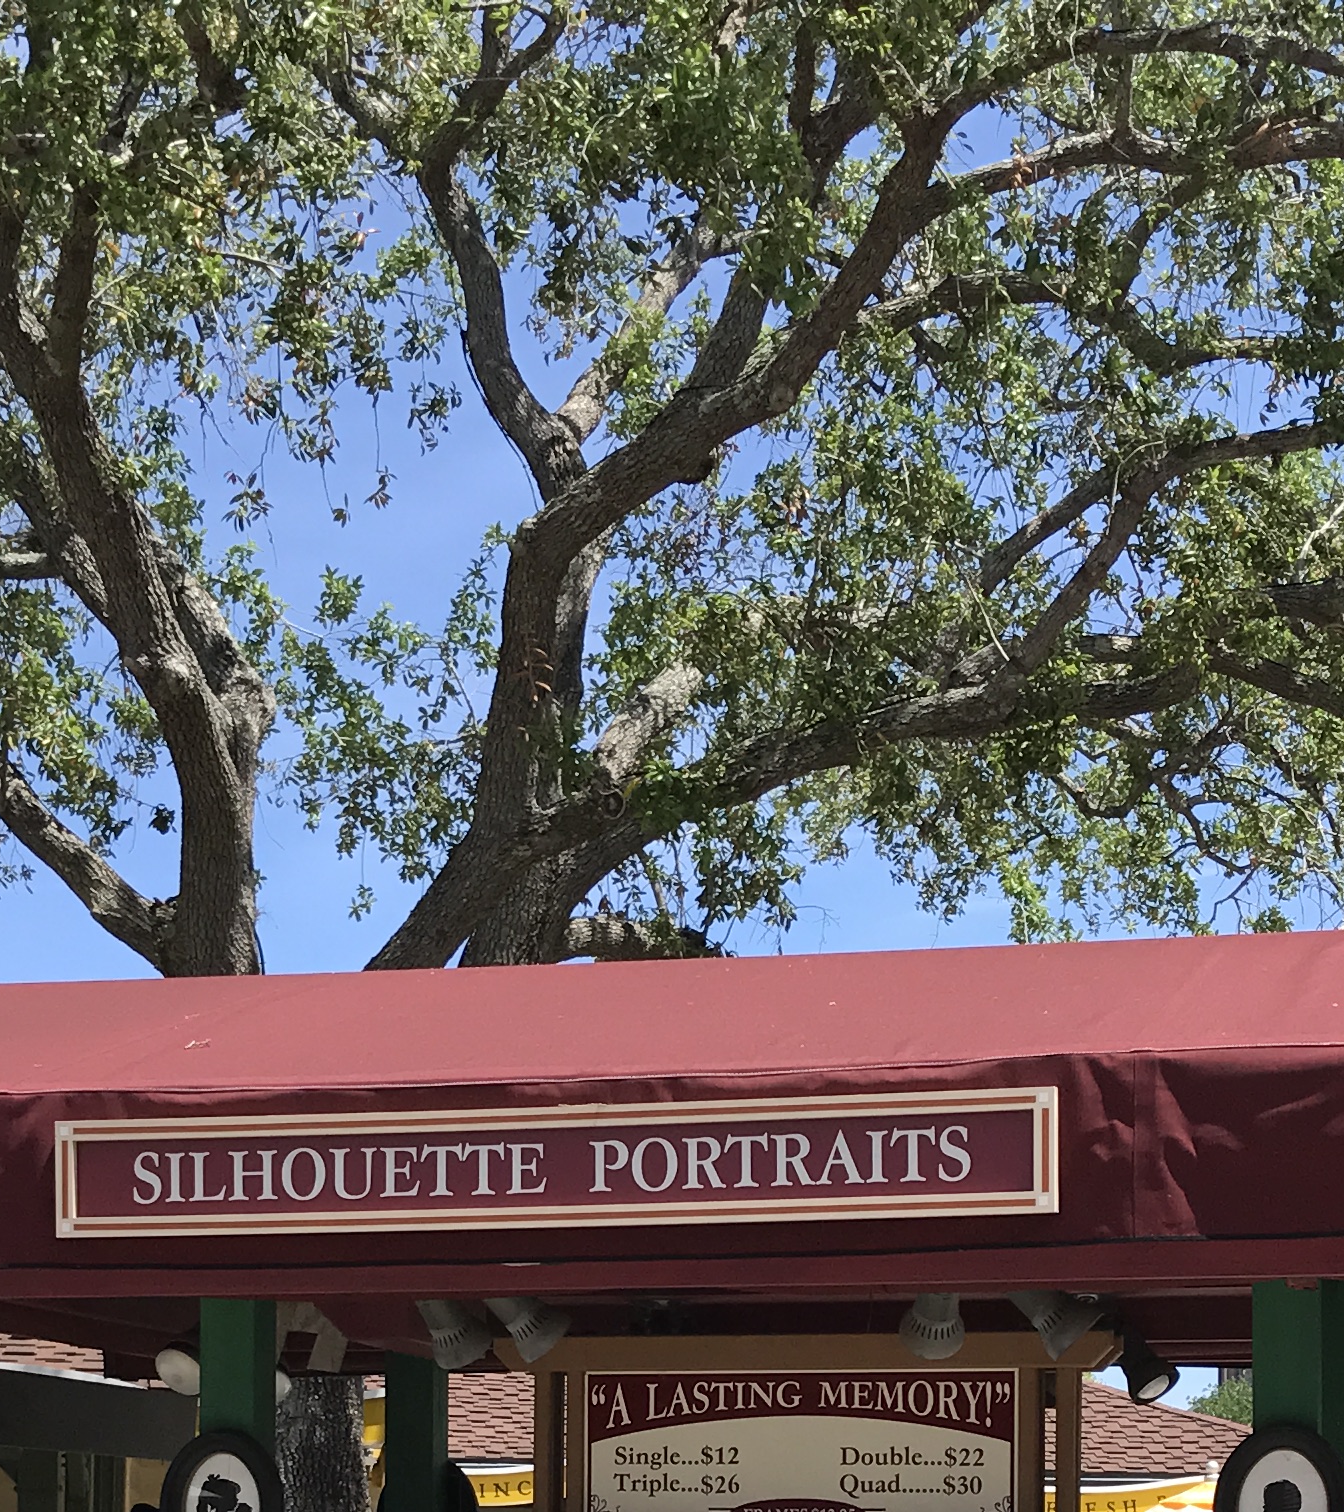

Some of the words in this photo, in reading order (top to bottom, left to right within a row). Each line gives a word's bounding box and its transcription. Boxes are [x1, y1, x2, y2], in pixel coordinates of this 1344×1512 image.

[132, 1141, 547, 1205] SILHOUETTE
[587, 1124, 975, 1193] PORTRAITS
[645, 1381, 803, 1421] LASTING
